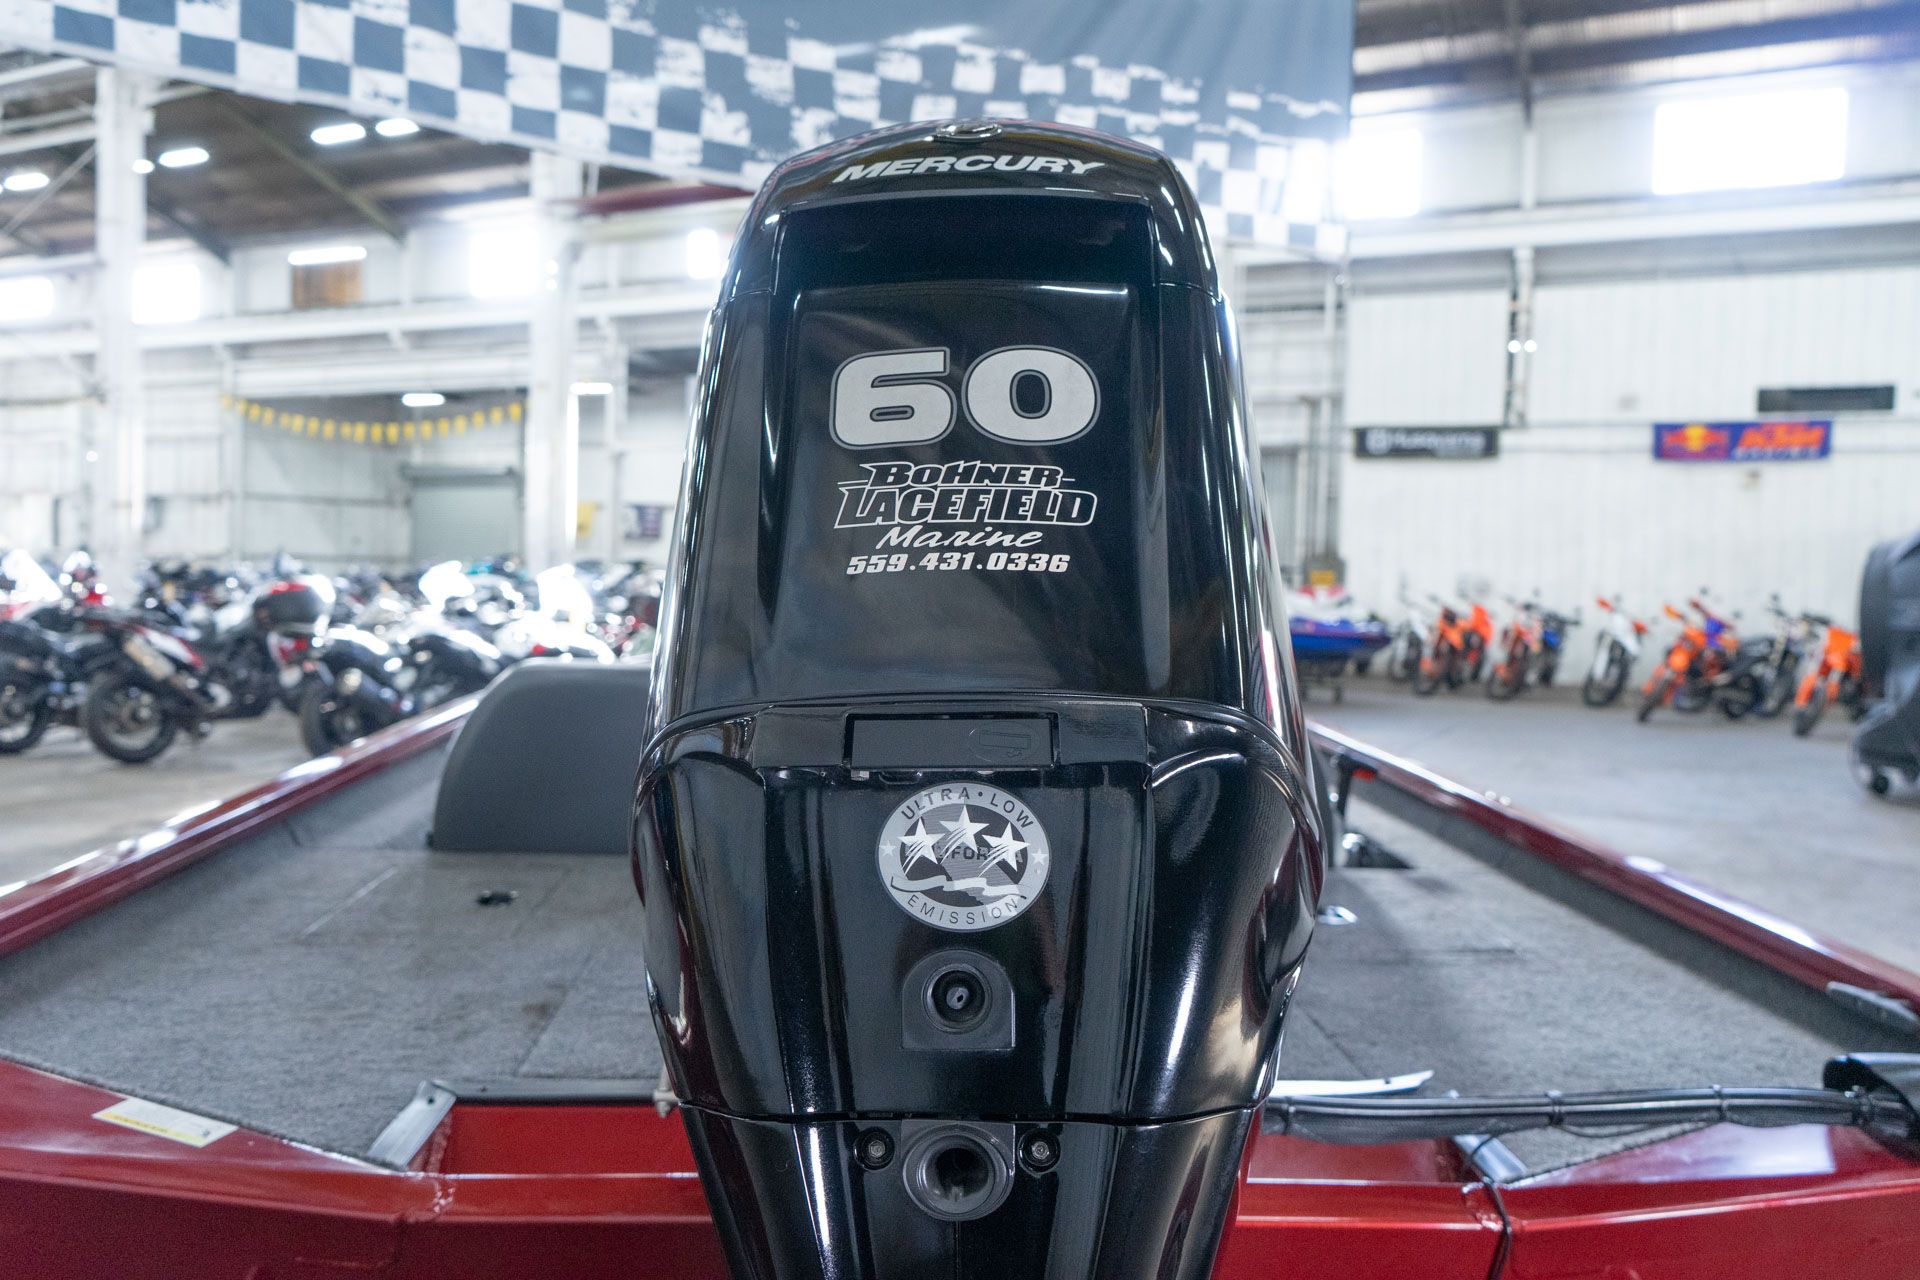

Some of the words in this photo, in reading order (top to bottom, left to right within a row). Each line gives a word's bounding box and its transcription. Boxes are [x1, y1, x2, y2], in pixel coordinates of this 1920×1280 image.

[832, 154, 1105, 183] MERCURY
[829, 344, 1101, 450] 60
[834, 486, 1098, 529] LACEFIELD
[875, 524, 1043, 549] Marine
[846, 552, 1071, 575] 559.431.0336
[902, 787, 970, 820] ULTRA
[990, 793, 1034, 829] LOW
[907, 894, 1018, 925] EMISSION
